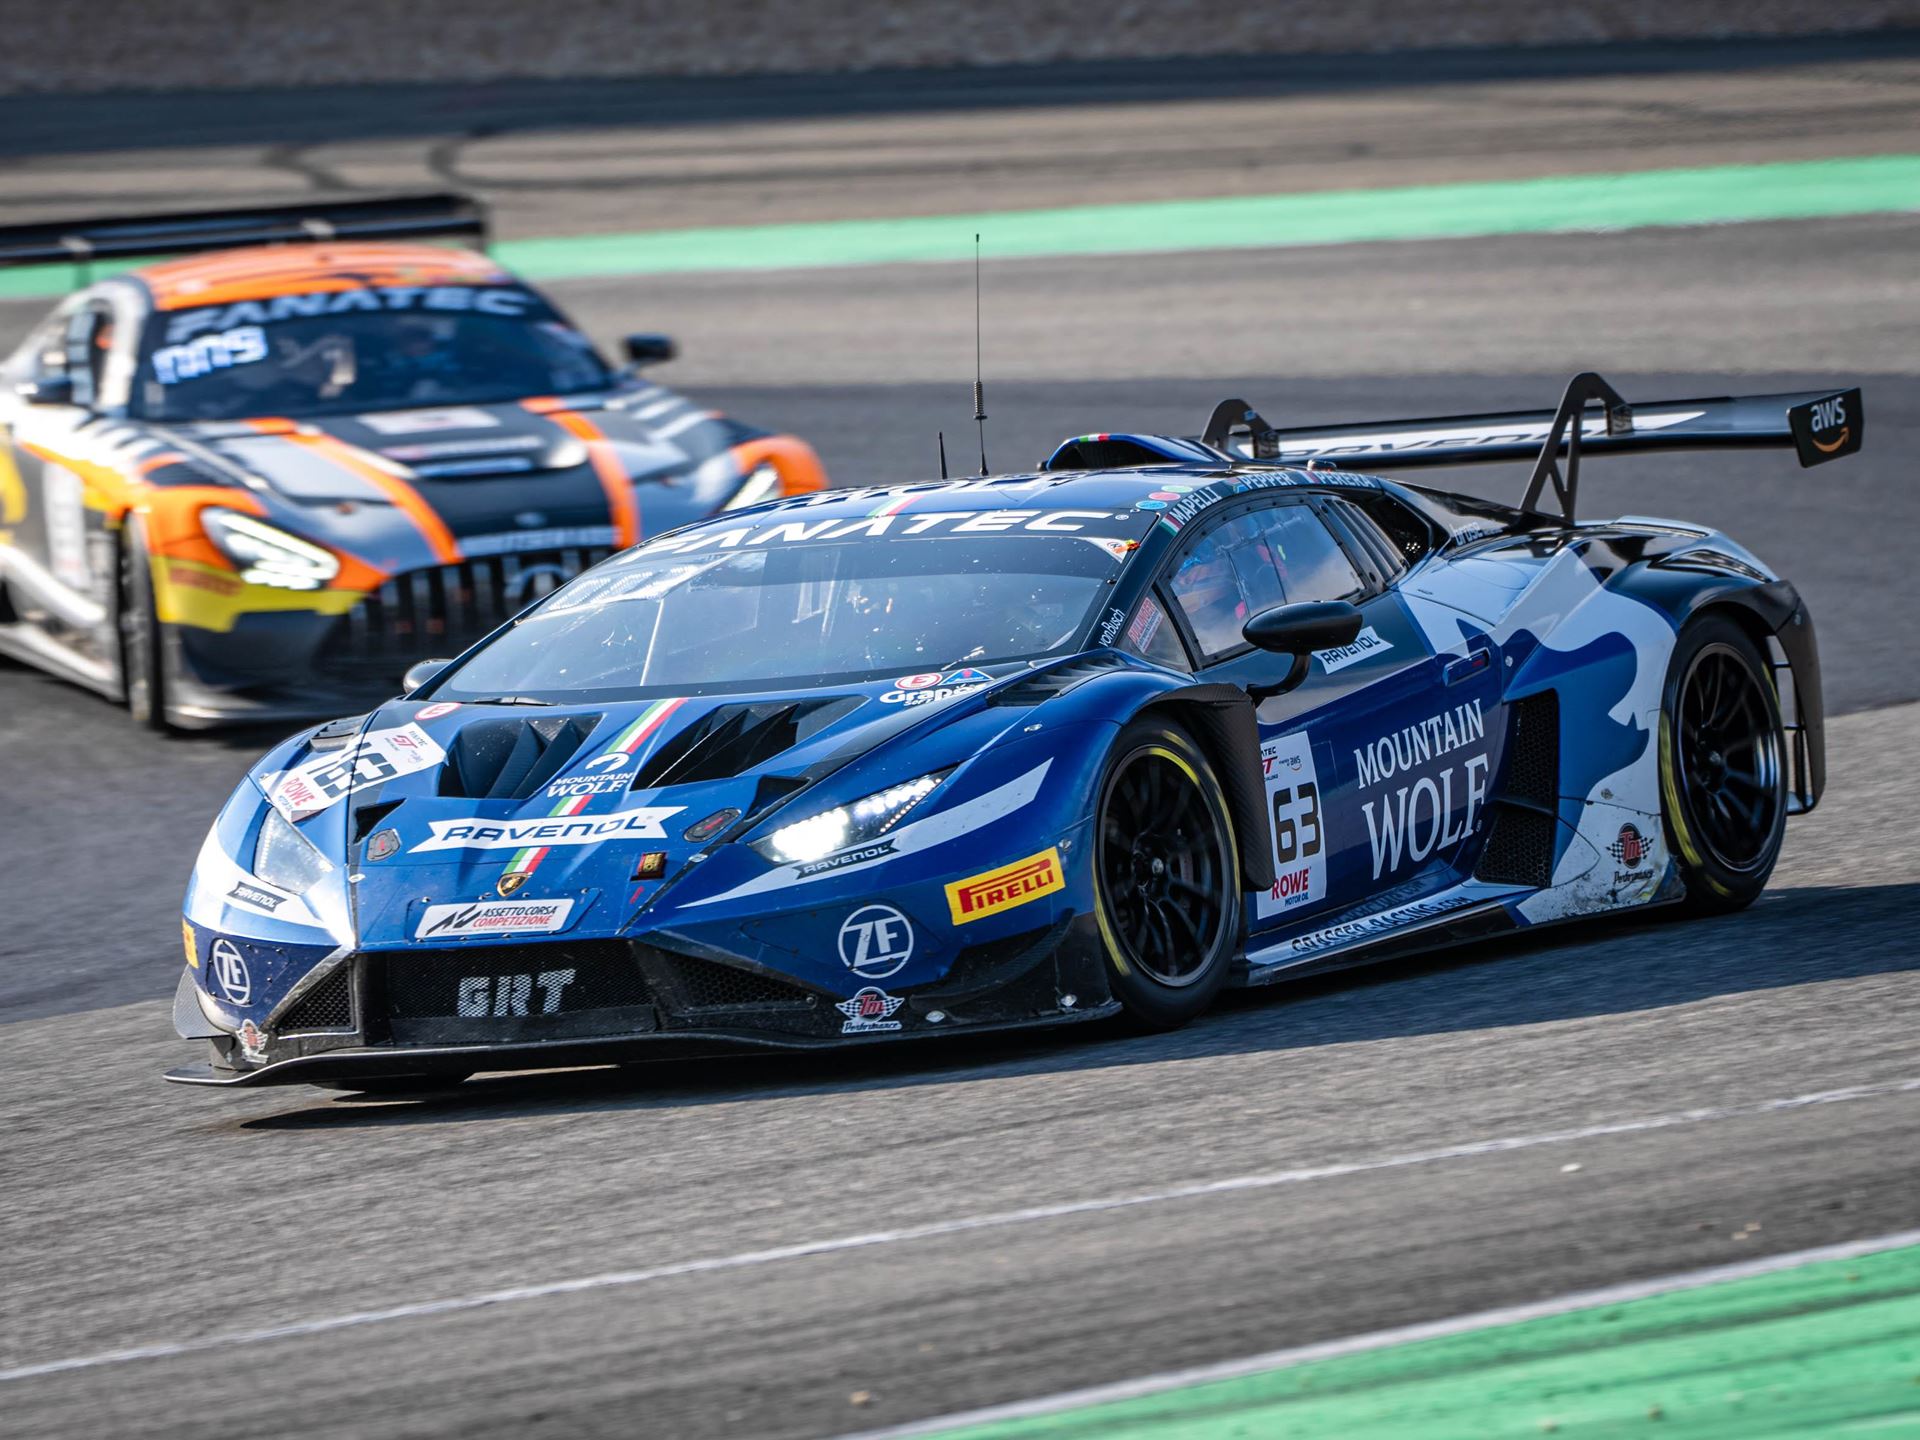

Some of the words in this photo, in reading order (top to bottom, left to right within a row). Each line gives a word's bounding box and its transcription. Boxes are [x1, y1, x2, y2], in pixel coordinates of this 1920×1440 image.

[165, 287, 535, 343] FANATEC
[1810, 396, 1847, 433] aws
[1240, 473, 1297, 490] PEPPER
[1168, 486, 1223, 526] MAPELLI
[616, 511, 1113, 565] FANATEC
[1098, 607, 1126, 647] vonBusch
[1320, 635, 1381, 665] RAVENOL
[1353, 698, 1485, 790] MOUNTAIN
[281, 777, 316, 807] ROWE
[547, 780, 629, 798] WOLF
[553, 772, 634, 786] MOUNTAIN
[441, 815, 648, 842] RAVENOL
[1361, 752, 1489, 881] WOLF
[804, 844, 890, 875] RAVENOL
[234, 886, 278, 909] RAVENOL
[957, 858, 1055, 914] PIRELLI
[1271, 868, 1310, 901] ROWE
[481, 906, 525, 918] ASSETTO
[525, 905, 558, 915] CORSA
[1284, 895, 1301, 908] MOTOR
[472, 914, 552, 929] COMPETIZIONE
[841, 912, 910, 970] ZF
[213, 947, 249, 996] ZF
[457, 968, 577, 1018] GRT
